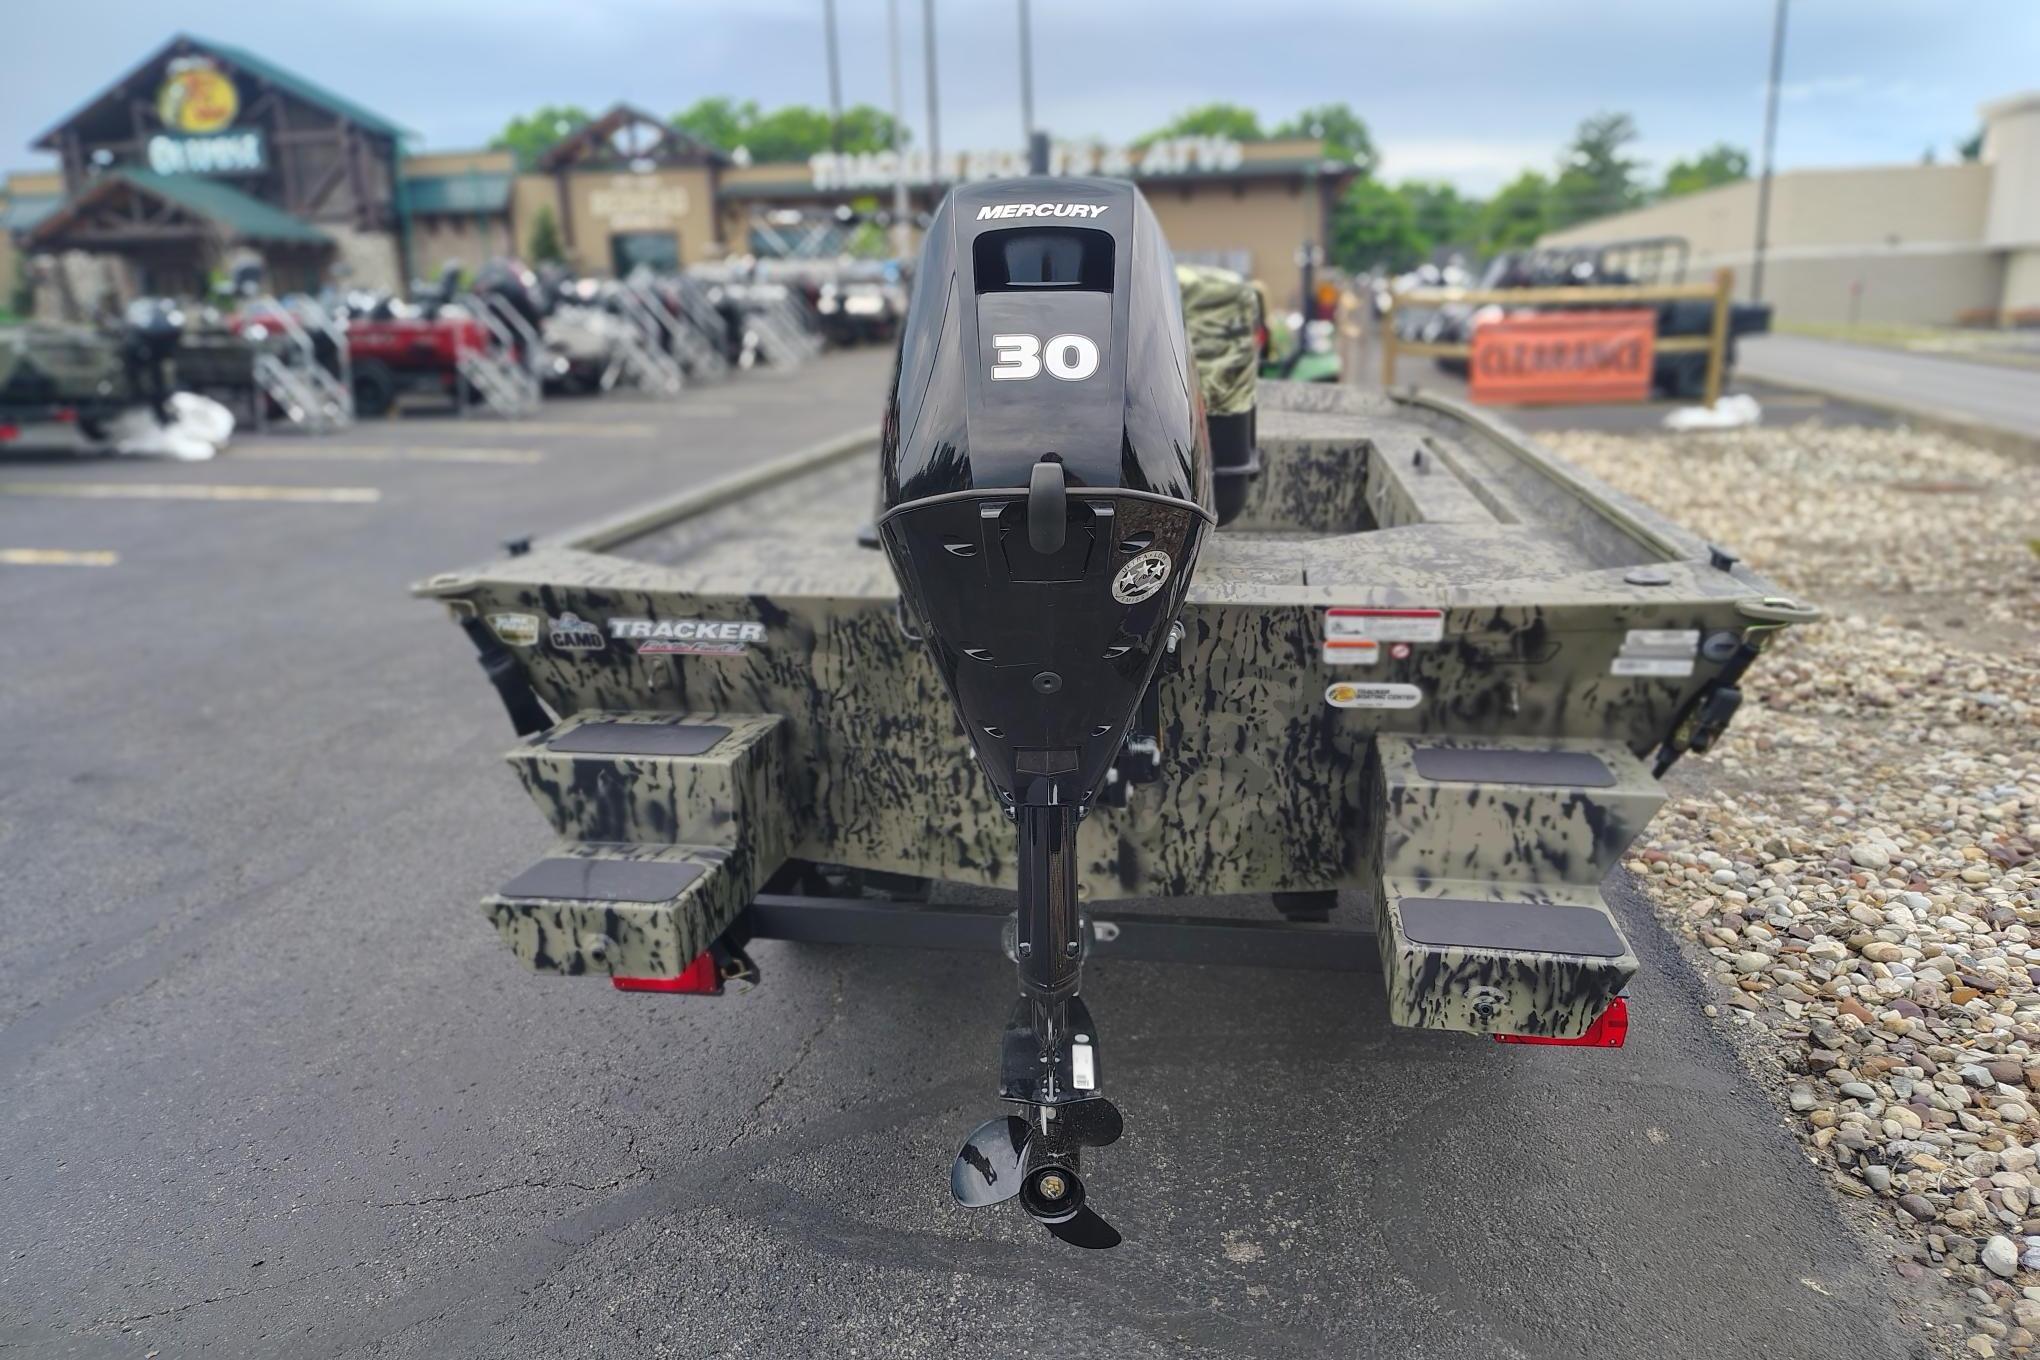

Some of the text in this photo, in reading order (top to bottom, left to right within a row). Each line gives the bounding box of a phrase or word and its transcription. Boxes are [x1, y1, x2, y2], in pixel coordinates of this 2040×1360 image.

[976, 203, 1109, 220] MERCURY
[990, 333, 1100, 382] 30
[612, 620, 763, 640] TRACKER
[552, 632, 602, 648] CAMO
